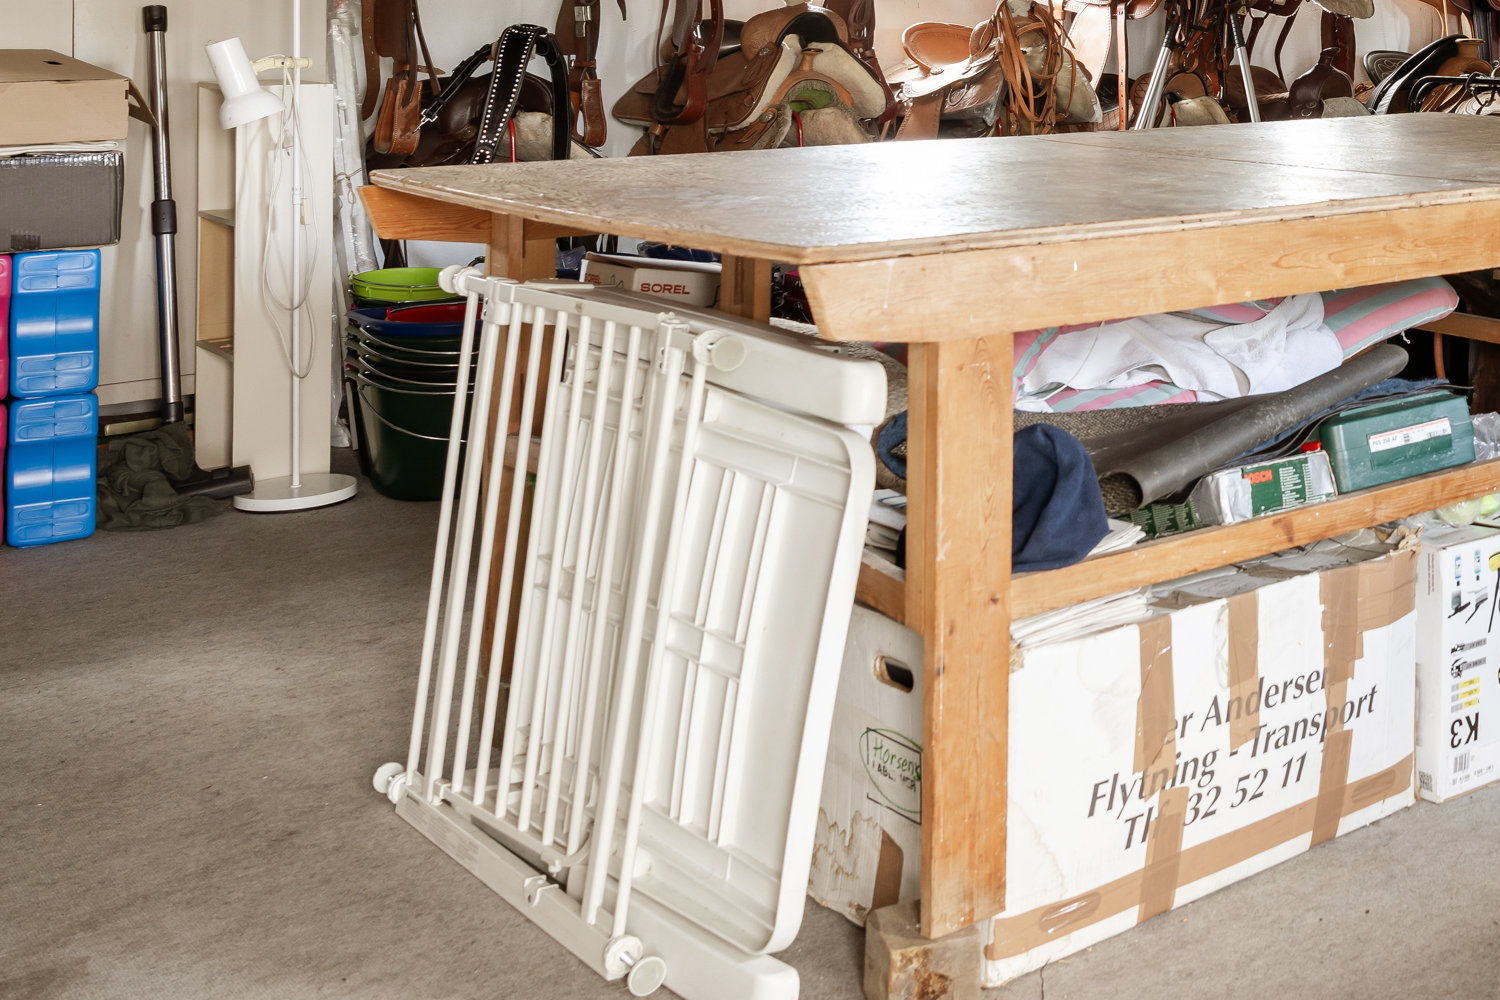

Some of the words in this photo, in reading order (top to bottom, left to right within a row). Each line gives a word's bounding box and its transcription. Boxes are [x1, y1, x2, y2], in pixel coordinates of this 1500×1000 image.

[640, 283, 690, 295] SOREL
[1087, 748, 1220, 820] Flytning
[1250, 684, 1378, 759] Transport
[1450, 712, 1479, 748] K3
[872, 735, 921, 782] Horsens
[1183, 785, 1222, 827] 32
[1230, 768, 1268, 809] 52
